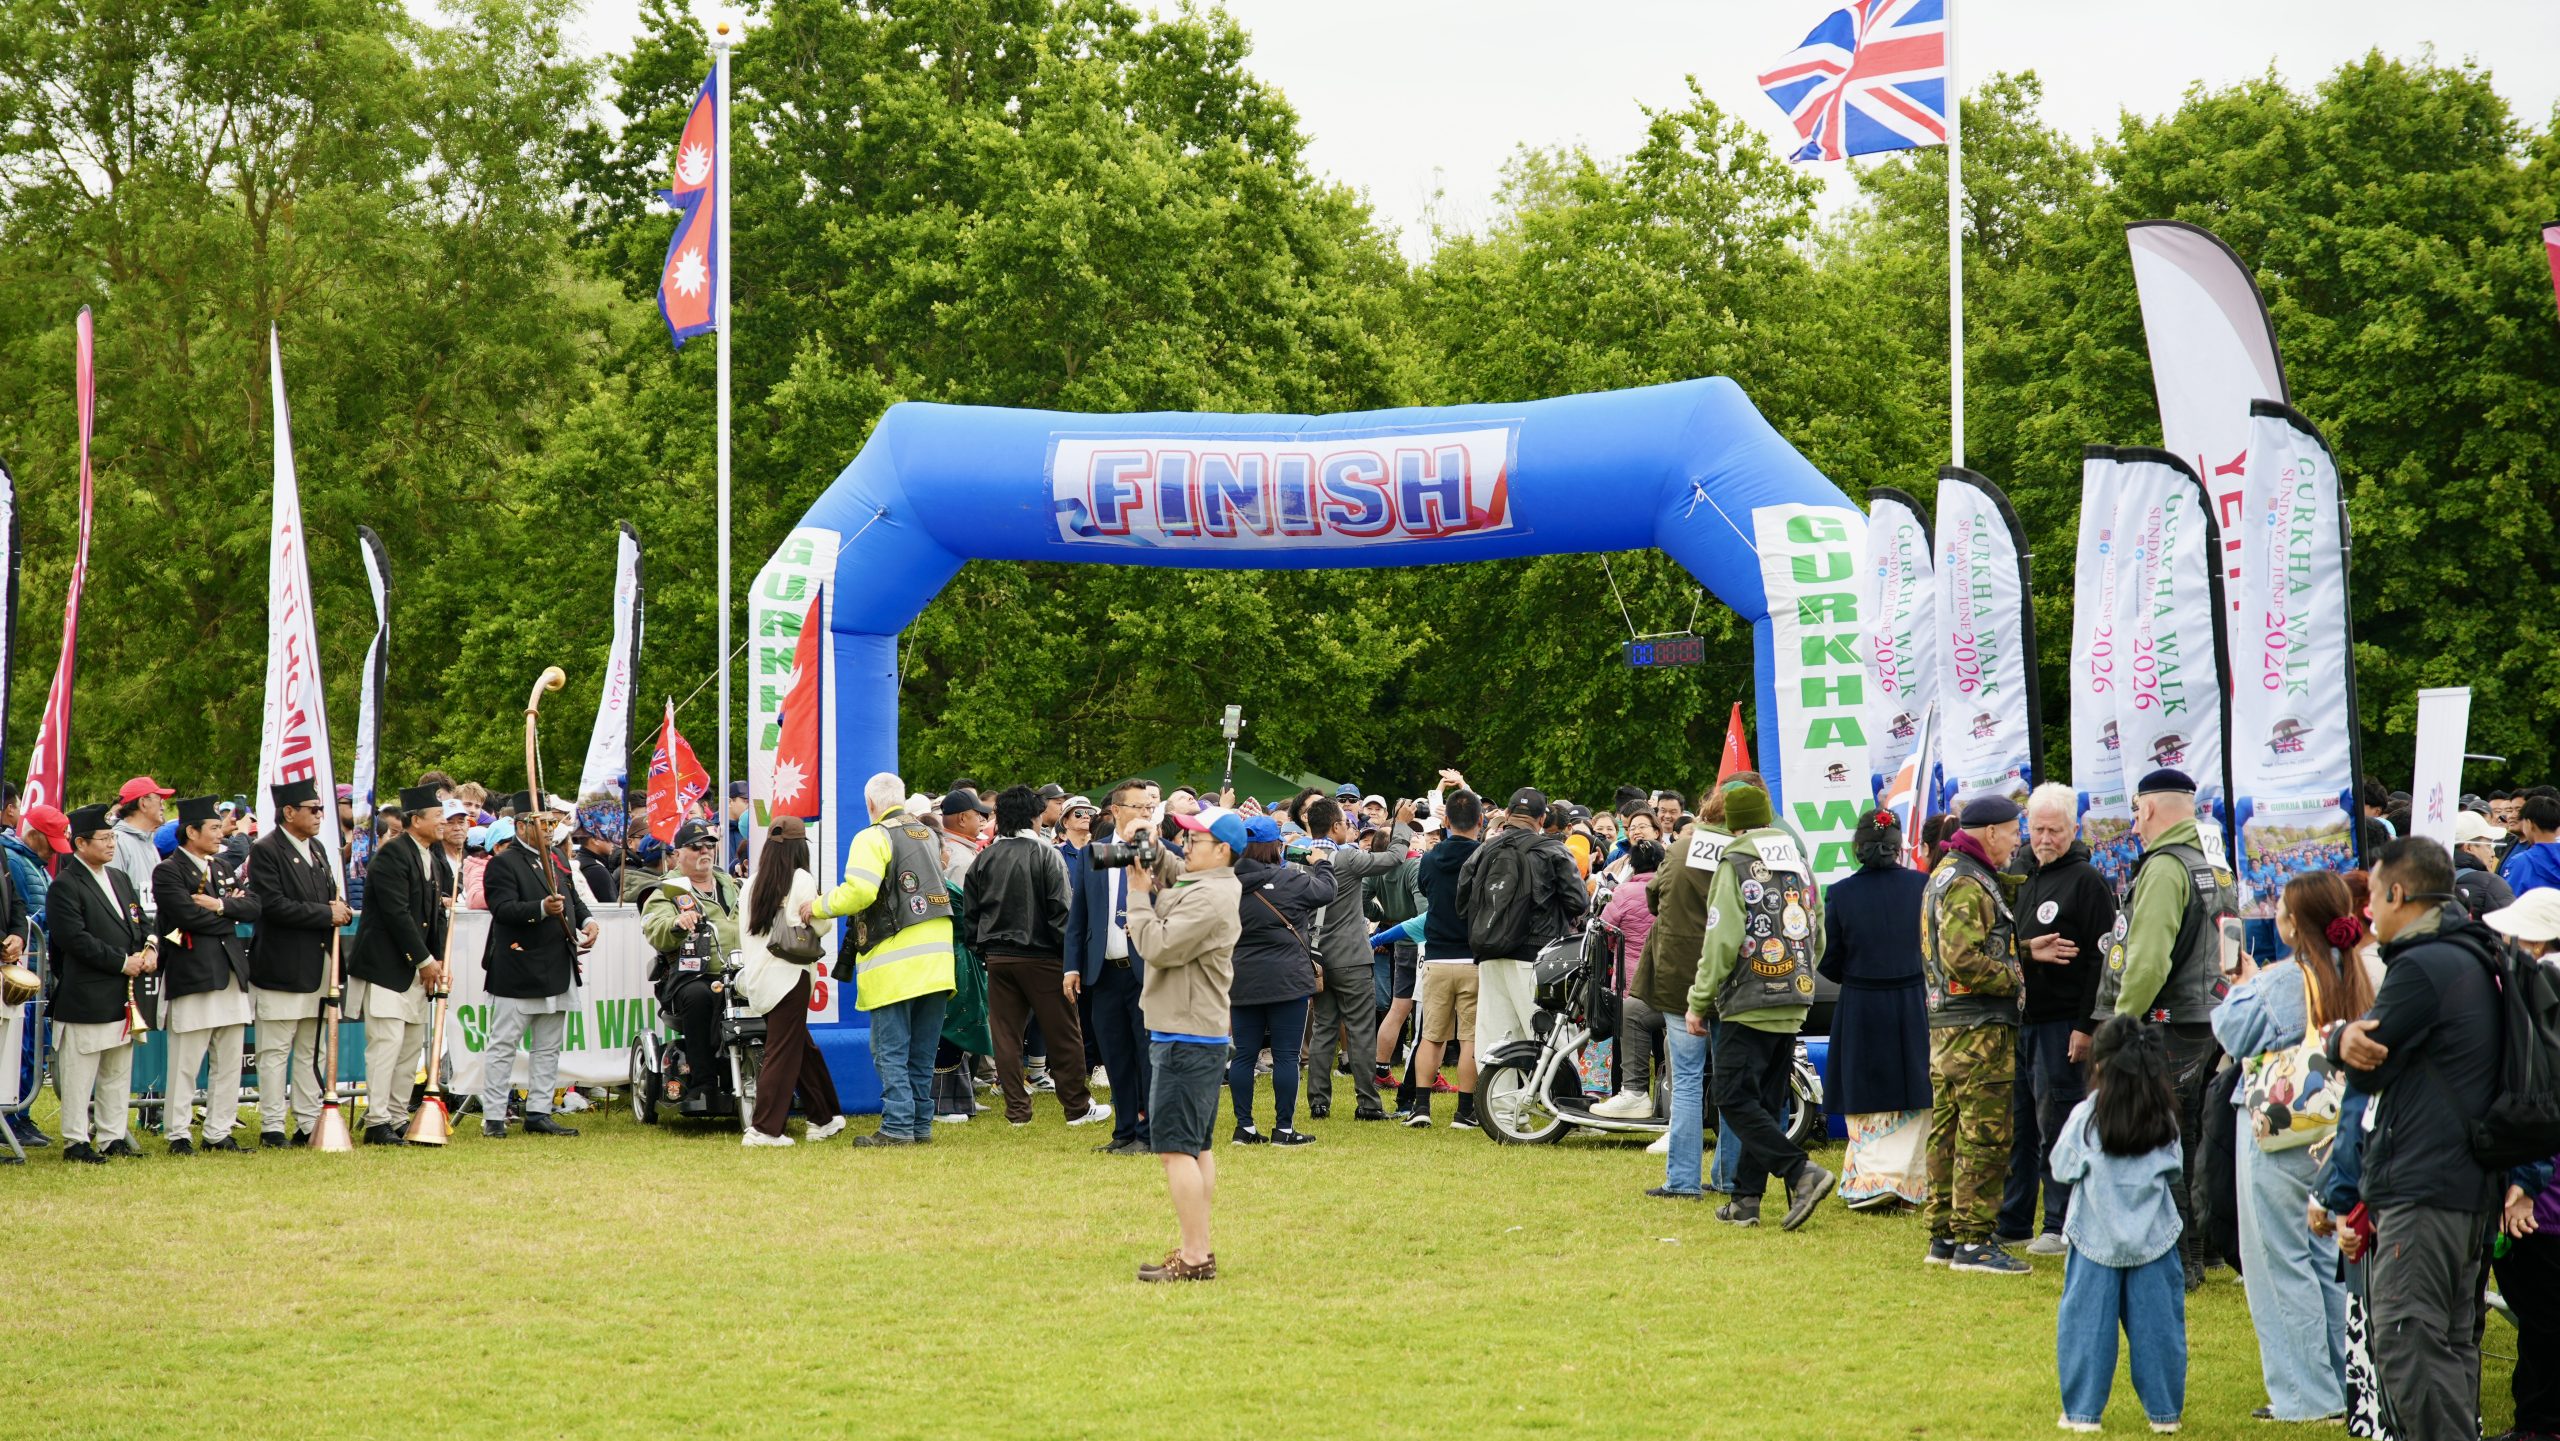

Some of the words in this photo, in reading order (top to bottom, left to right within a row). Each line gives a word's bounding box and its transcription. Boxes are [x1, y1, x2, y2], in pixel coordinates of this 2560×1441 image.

[1088, 443, 1472, 537] FINISH
[2287, 457, 2316, 596] GURKHA
[1895, 524, 1917, 622] GURKHA
[1971, 513, 1993, 619] GURKHA
[2271, 566, 2285, 609] JUNE
[1786, 515, 1868, 749] GURKHA
[1957, 597, 1970, 630] JUNE
[1874, 635, 1899, 693] 2026
[1895, 630, 1917, 700] WALK
[1952, 632, 1982, 693] 2026
[1976, 628, 2000, 698] WALK
[2091, 624, 2115, 693] 2026
[2133, 638, 2161, 711] 2026
[2156, 631, 2188, 718] WALK
[2263, 610, 2287, 691] 2026
[2285, 610, 2311, 698] WALK
[2270, 801, 2300, 812] GURKHA
[2301, 799, 2321, 810] WALK
[1752, 958, 1794, 976] RIDER
